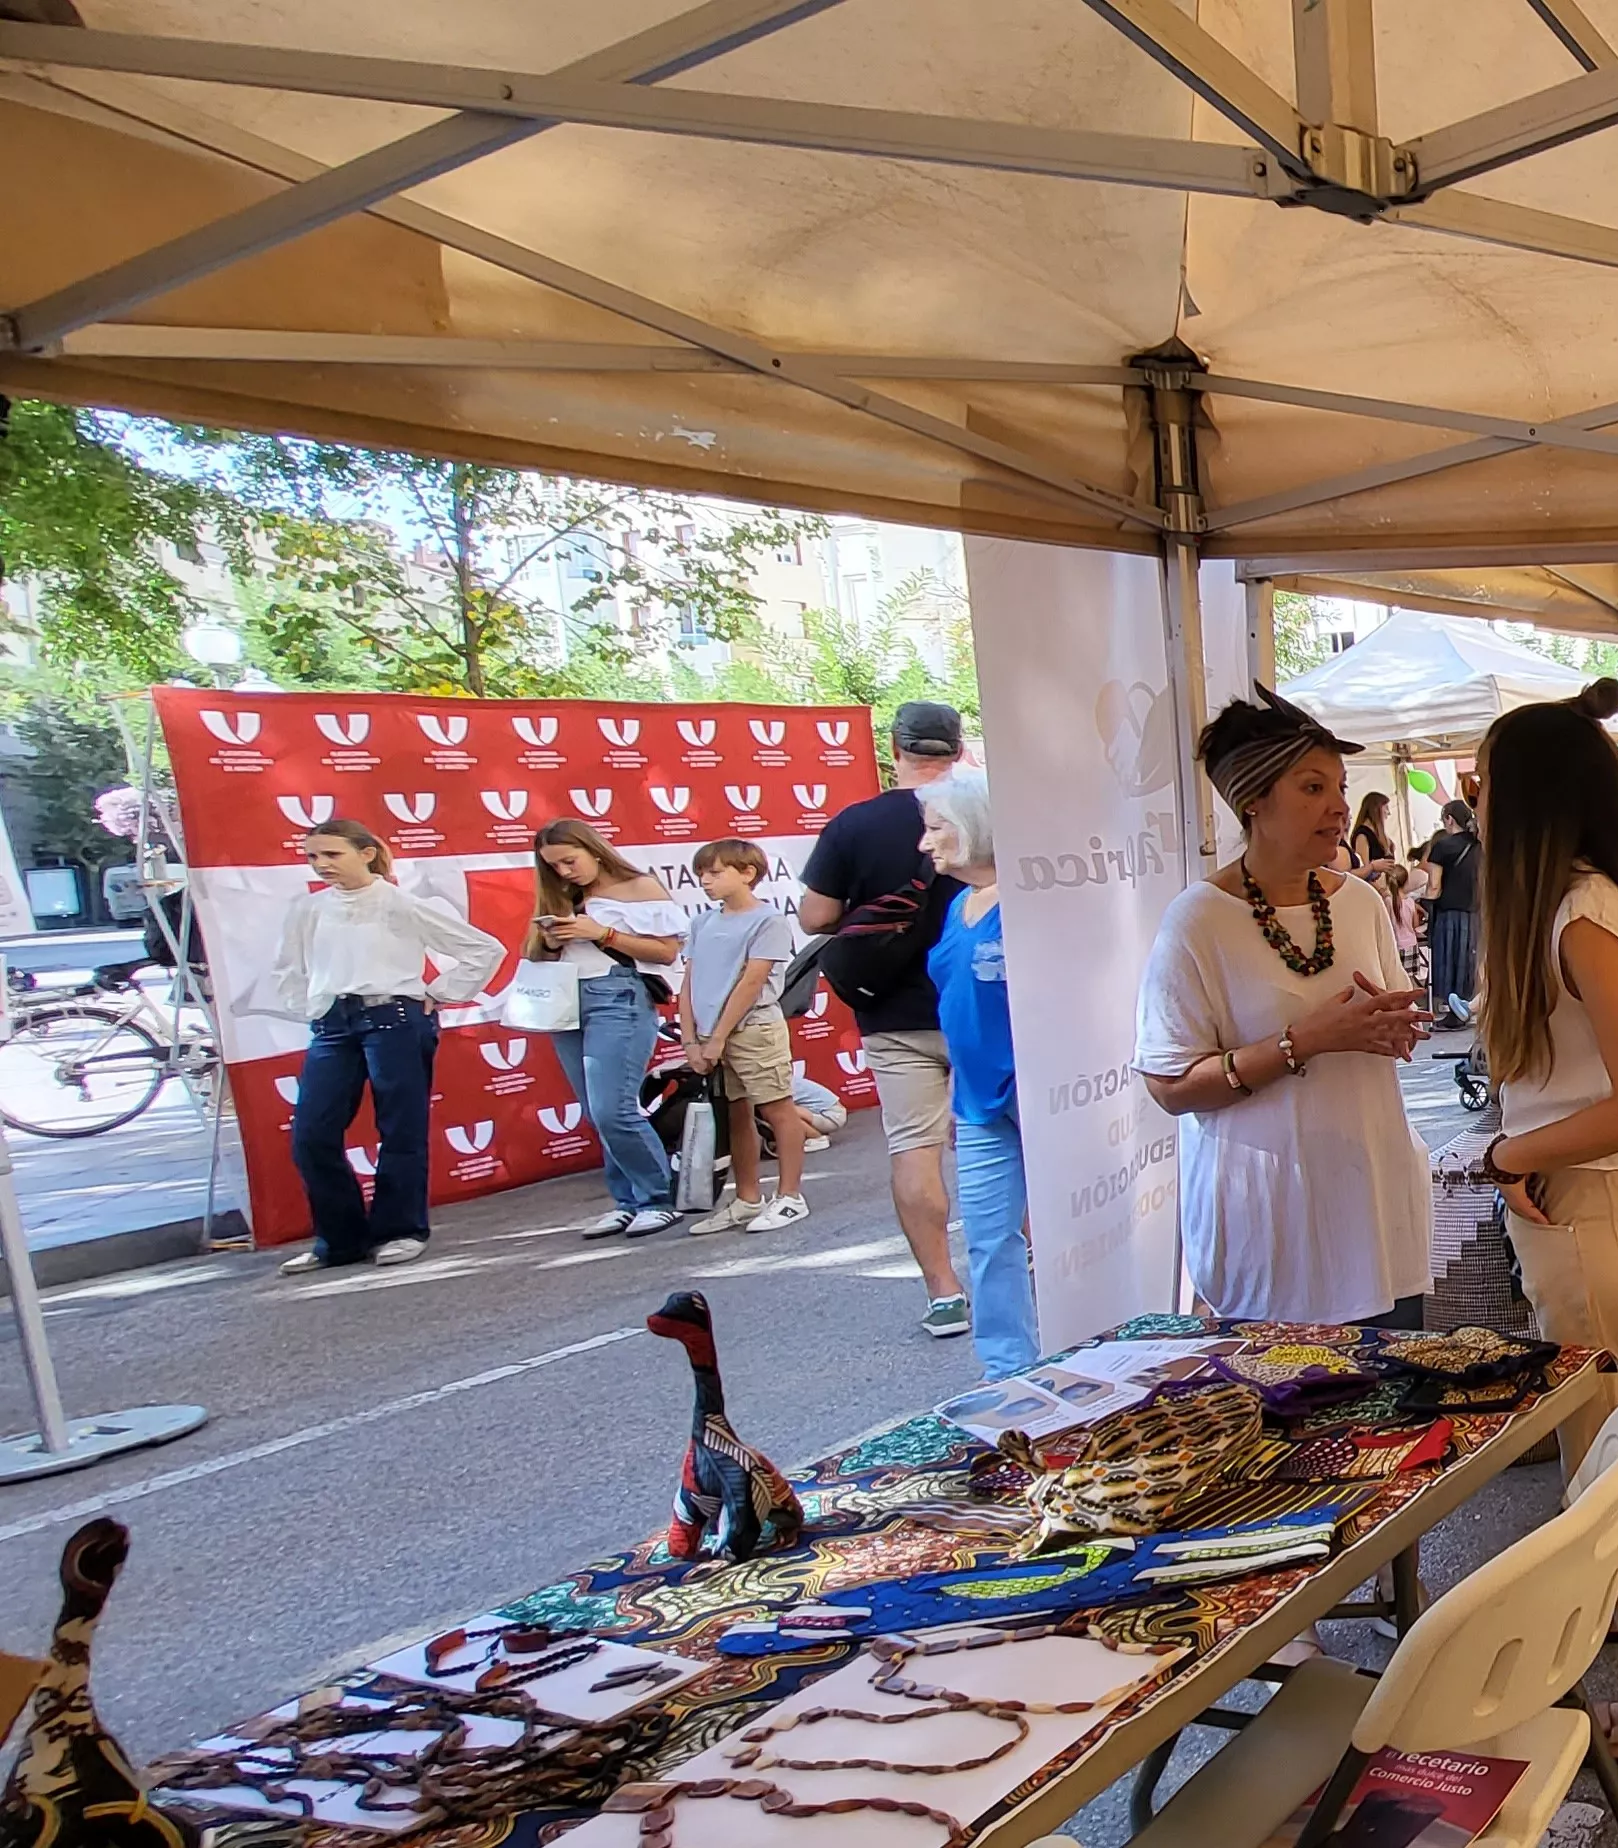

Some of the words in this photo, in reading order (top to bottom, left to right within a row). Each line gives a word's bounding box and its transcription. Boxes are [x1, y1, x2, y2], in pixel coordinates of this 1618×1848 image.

[1397, 1751, 1489, 1776] recetario
[1369, 1767, 1434, 1789] Comercio
[1433, 1780, 1473, 1796] Justo
